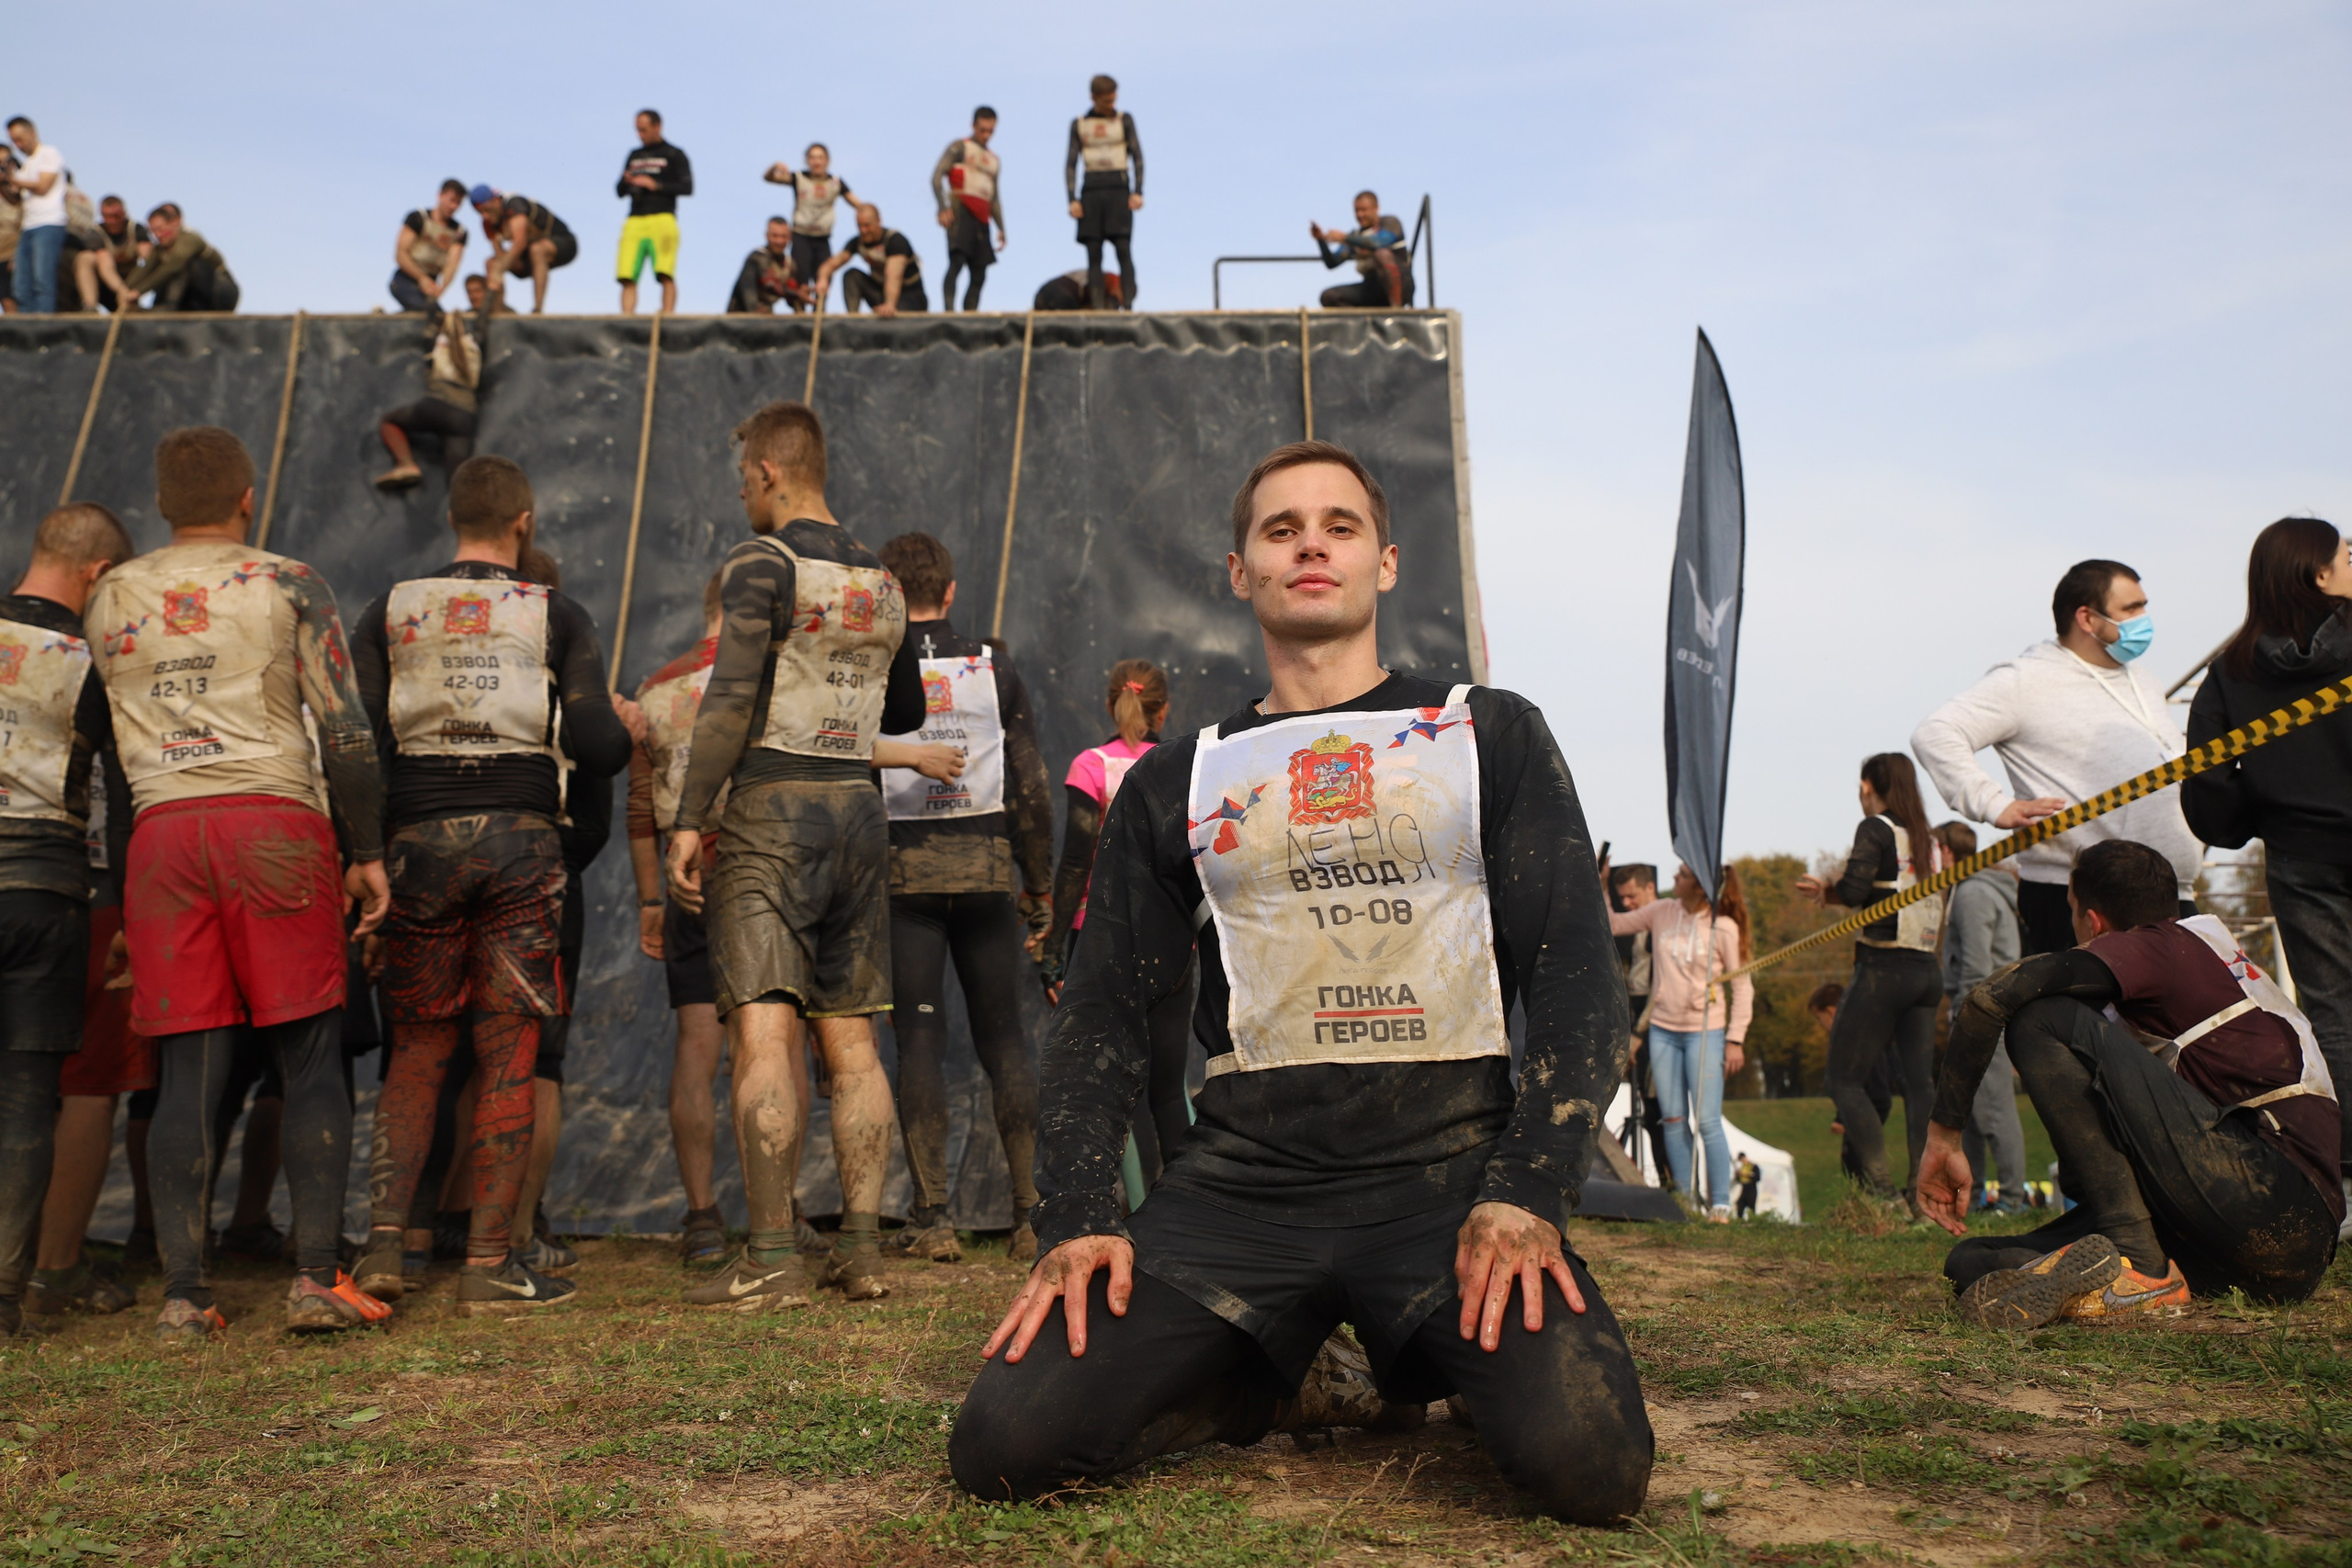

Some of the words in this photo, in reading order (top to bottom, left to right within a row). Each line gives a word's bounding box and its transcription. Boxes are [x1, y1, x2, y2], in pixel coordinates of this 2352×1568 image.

[153, 654, 217, 674] ВЗВОД
[441, 655, 500, 669] ВЗВОД
[829, 650, 871, 668] ВЗВОД
[151, 677, 208, 698] 42-13
[444, 675, 500, 690] 42-03
[826, 671, 865, 689] 42-01
[443, 718, 493, 733] ГОНКА
[919, 728, 967, 740] ВЗВОД
[814, 735, 856, 750] ГЕРОЕВ
[162, 742, 224, 763] ГЕРОЕВ
[926, 798, 972, 810] ГЕРОЕВ
[1289, 861, 1406, 892] ВЗВОД
[1307, 898, 1413, 929] 10-08
[1317, 983, 1418, 1008] ГОНКА
[1314, 1018, 1427, 1043] ГЕРОЕВ
